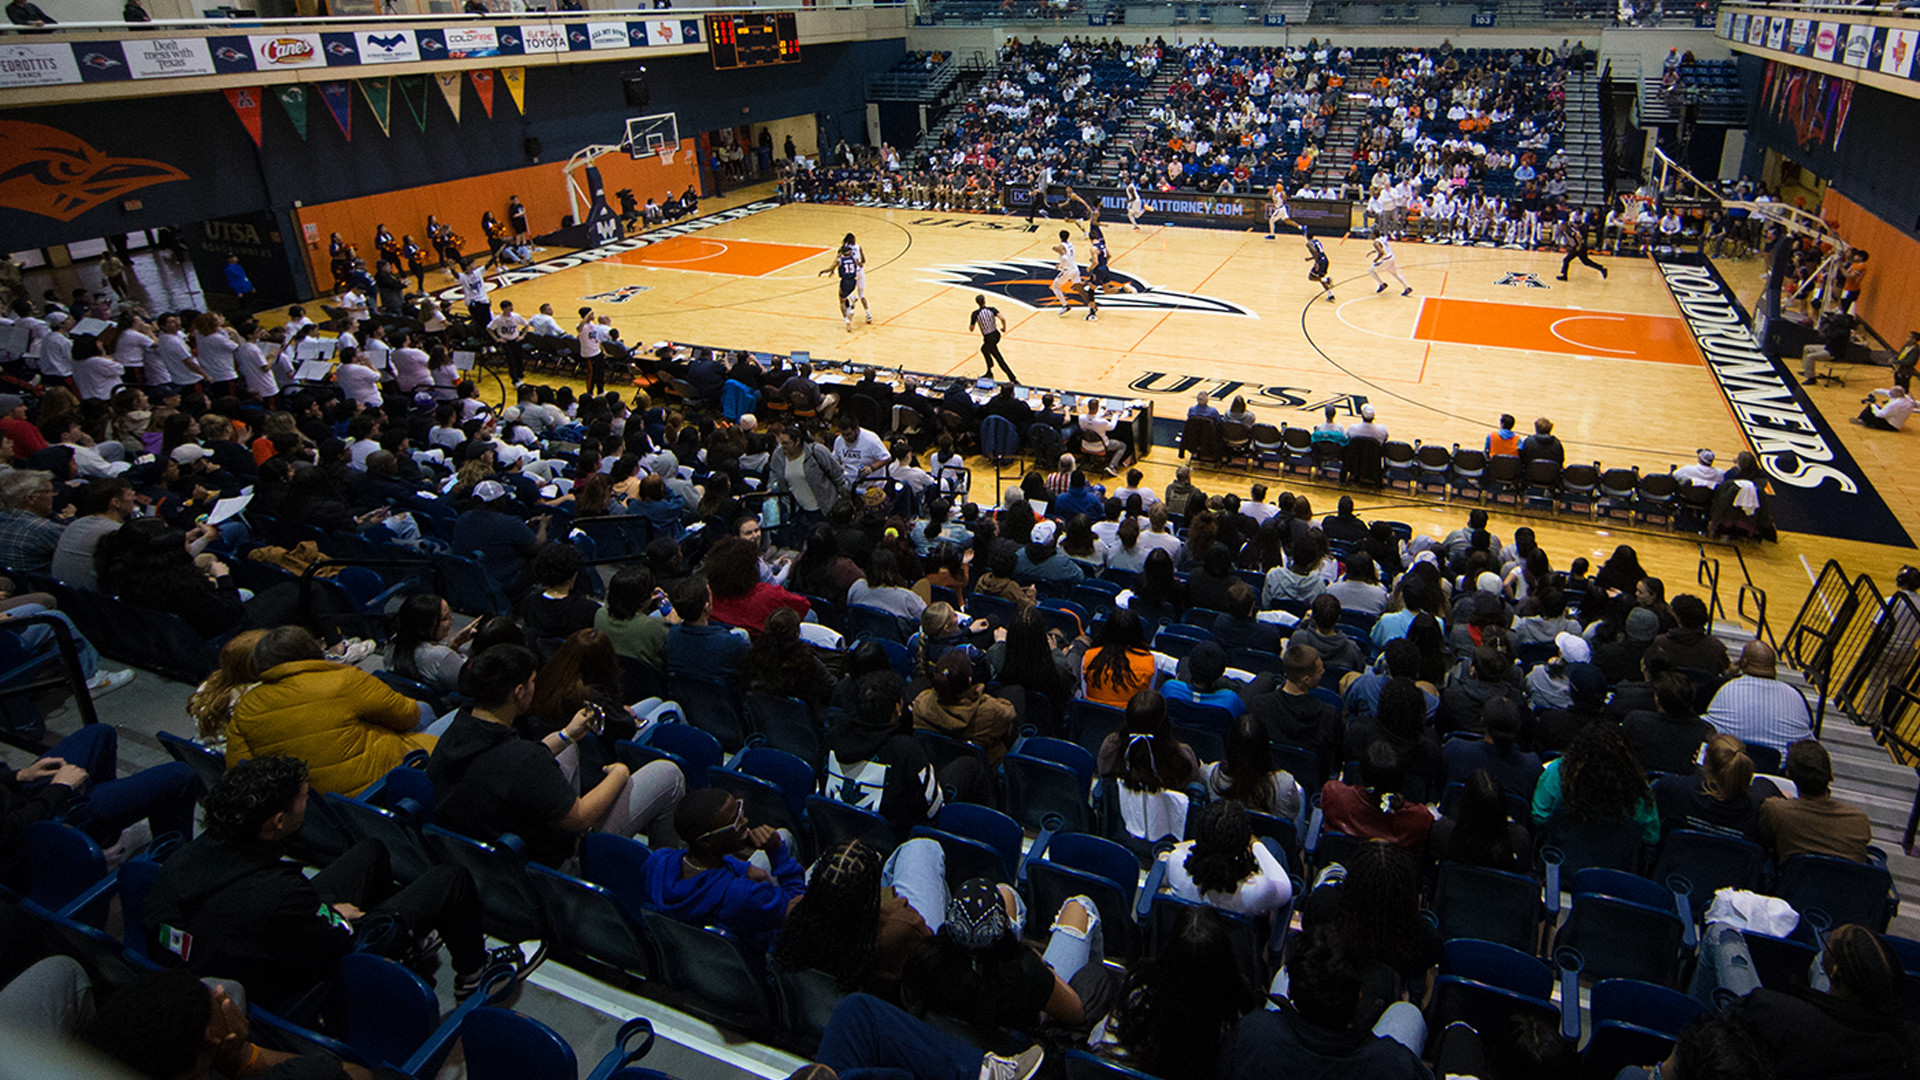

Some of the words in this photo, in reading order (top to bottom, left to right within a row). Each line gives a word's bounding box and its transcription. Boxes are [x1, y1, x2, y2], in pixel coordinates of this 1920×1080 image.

[1475, 16, 1490, 24] 103
[525, 38, 567, 49] TOYOTA
[144, 51, 171, 60] mess
[171, 47, 195, 59] with
[204, 220, 261, 245] UTSA
[843, 263, 855, 274] 15
[1658, 261, 1859, 495] ROADRUNNERS
[1128, 371, 1374, 418] UTSA
[843, 449, 862, 460] VANS
